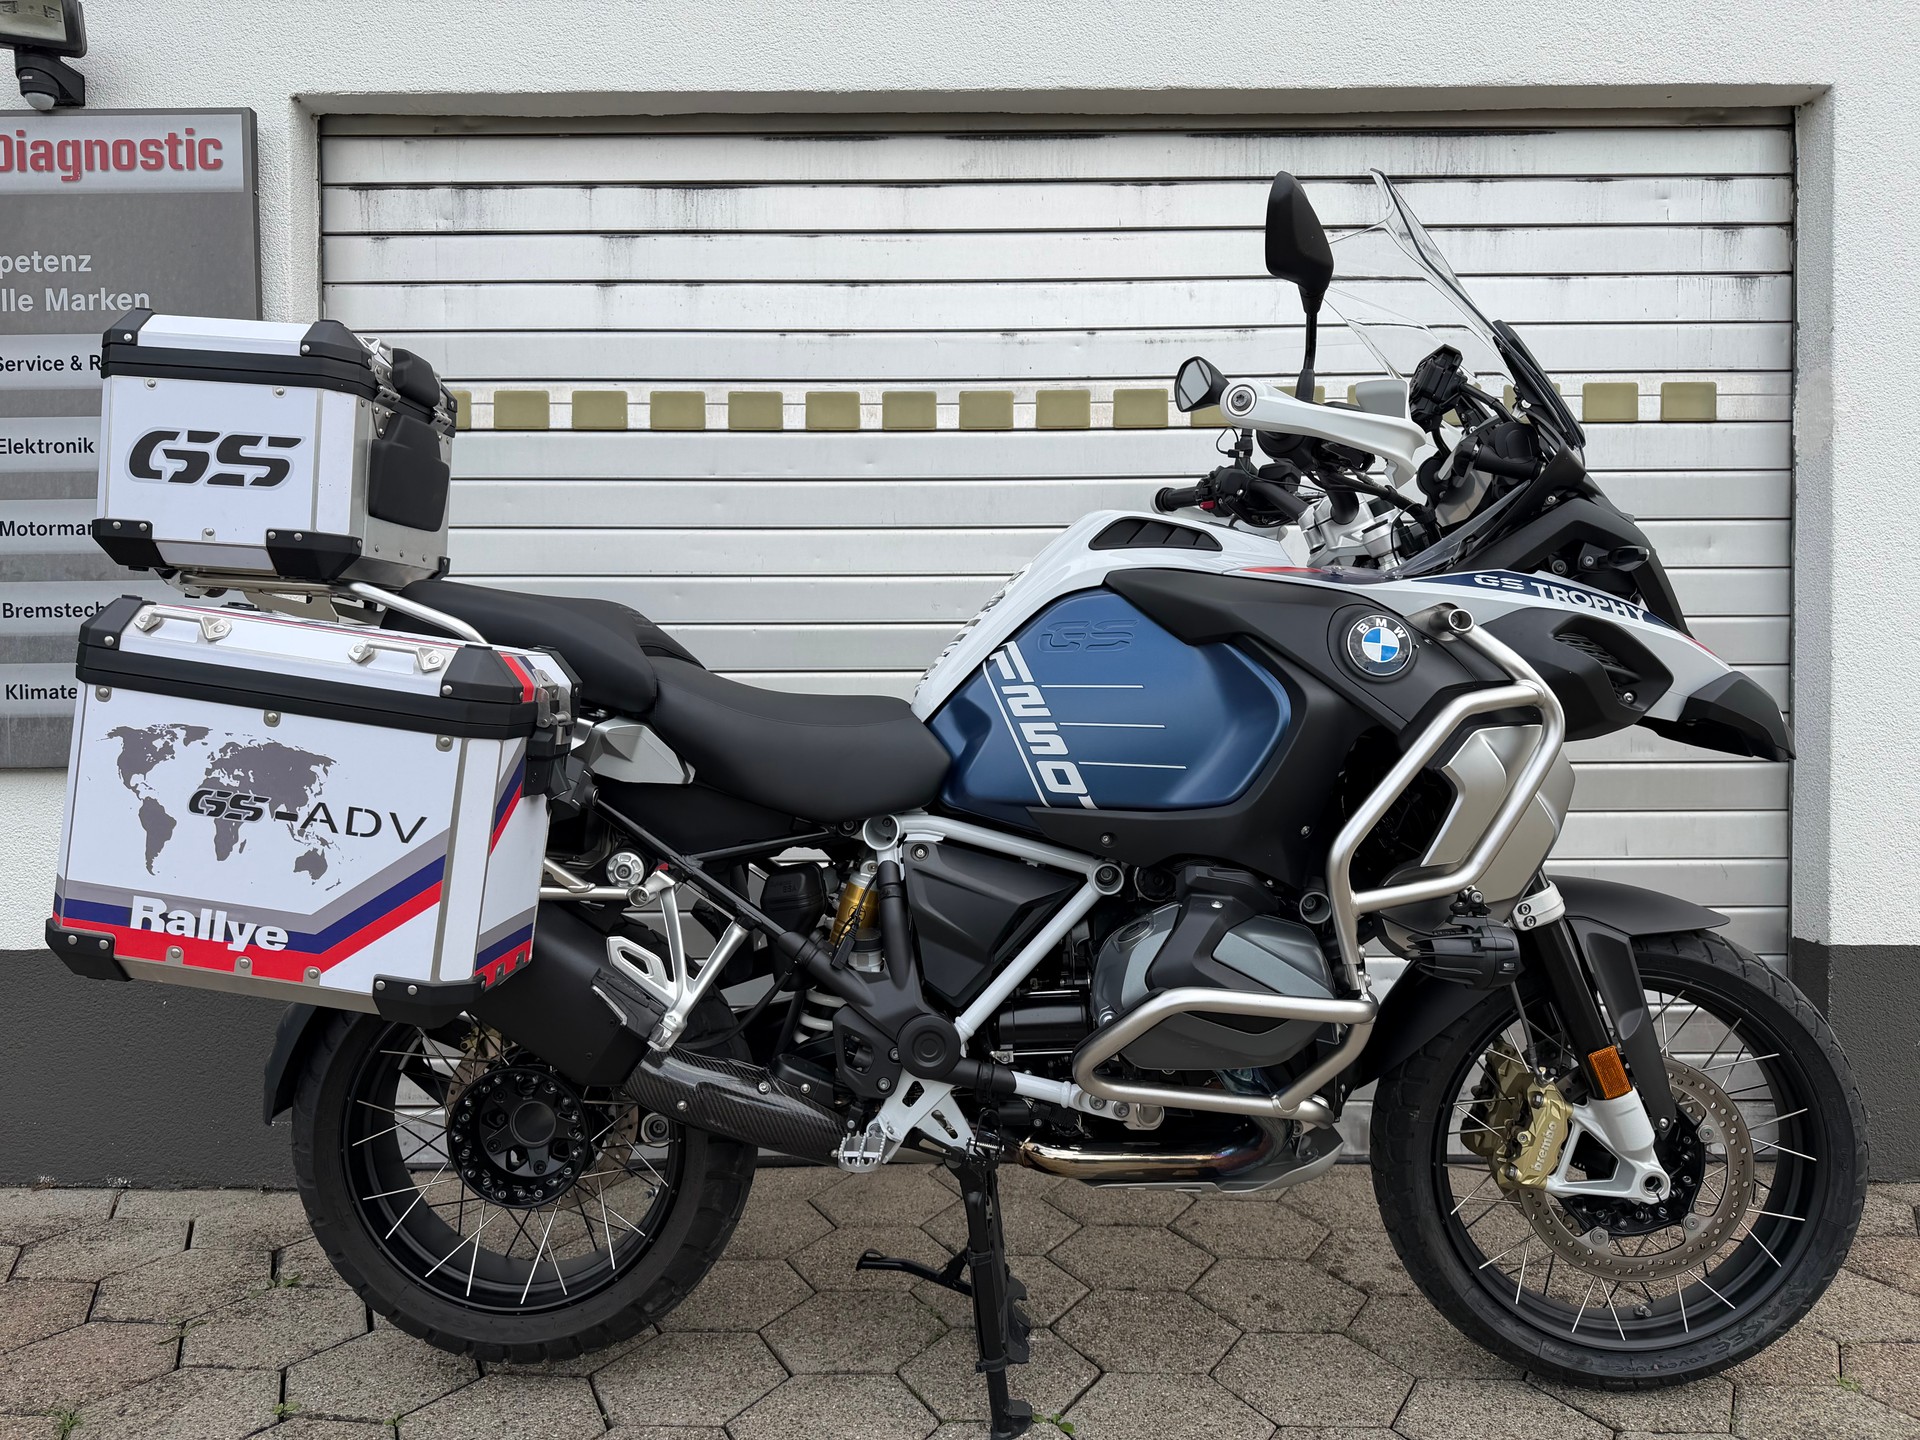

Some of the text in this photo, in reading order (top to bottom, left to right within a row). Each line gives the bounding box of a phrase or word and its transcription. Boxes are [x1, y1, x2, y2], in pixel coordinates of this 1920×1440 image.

[0, 128, 223, 182] Diagnostic
[0, 250, 92, 280] petenz
[45, 286, 151, 312] Marken
[70, 354, 83, 371] &
[0, 436, 95, 455] Elektronik
[129, 429, 302, 487] GS
[1473, 574, 1644, 623] GS TROPHY
[1037, 618, 1140, 653] GS
[1356, 617, 1407, 639] BMW
[5, 683, 77, 700] Klimate
[130, 896, 289, 952] Rallye
[1531, 1121, 1556, 1171] brembo
